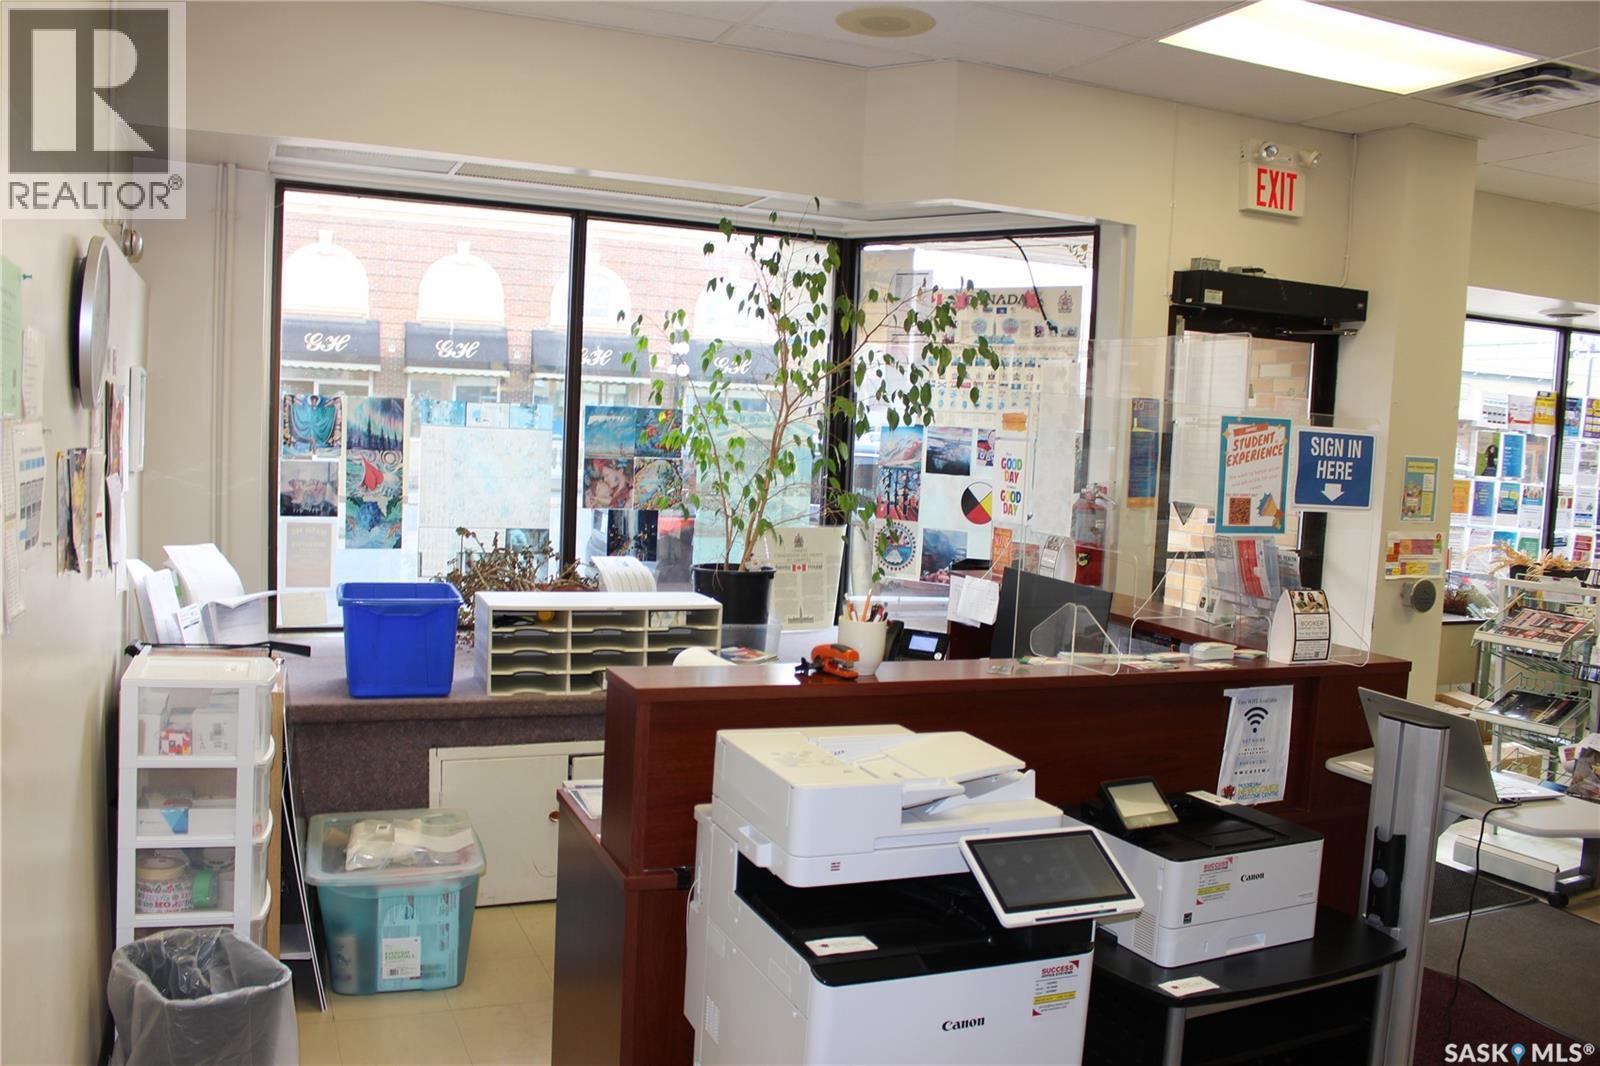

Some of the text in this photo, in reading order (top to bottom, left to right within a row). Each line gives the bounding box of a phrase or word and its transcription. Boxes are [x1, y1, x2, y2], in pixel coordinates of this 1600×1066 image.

[1256, 167, 1298, 211] EXIT
[965, 293, 1027, 306] CNADA
[1232, 431, 1275, 452] STUDENT
[1310, 436, 1362, 459] SIGN IN
[1226, 443, 1284, 467] EXPERIENCE
[1000, 457, 1023, 471] GOOD
[1316, 460, 1353, 480] HERE
[1004, 470, 1020, 484] DAY
[1000, 489, 1022, 503] GOOD
[1003, 502, 1018, 516] DAY
[1240, 872, 1265, 882] Canon
[1041, 964, 1074, 975] SUCCESS
[942, 1017, 985, 1031] Canon
